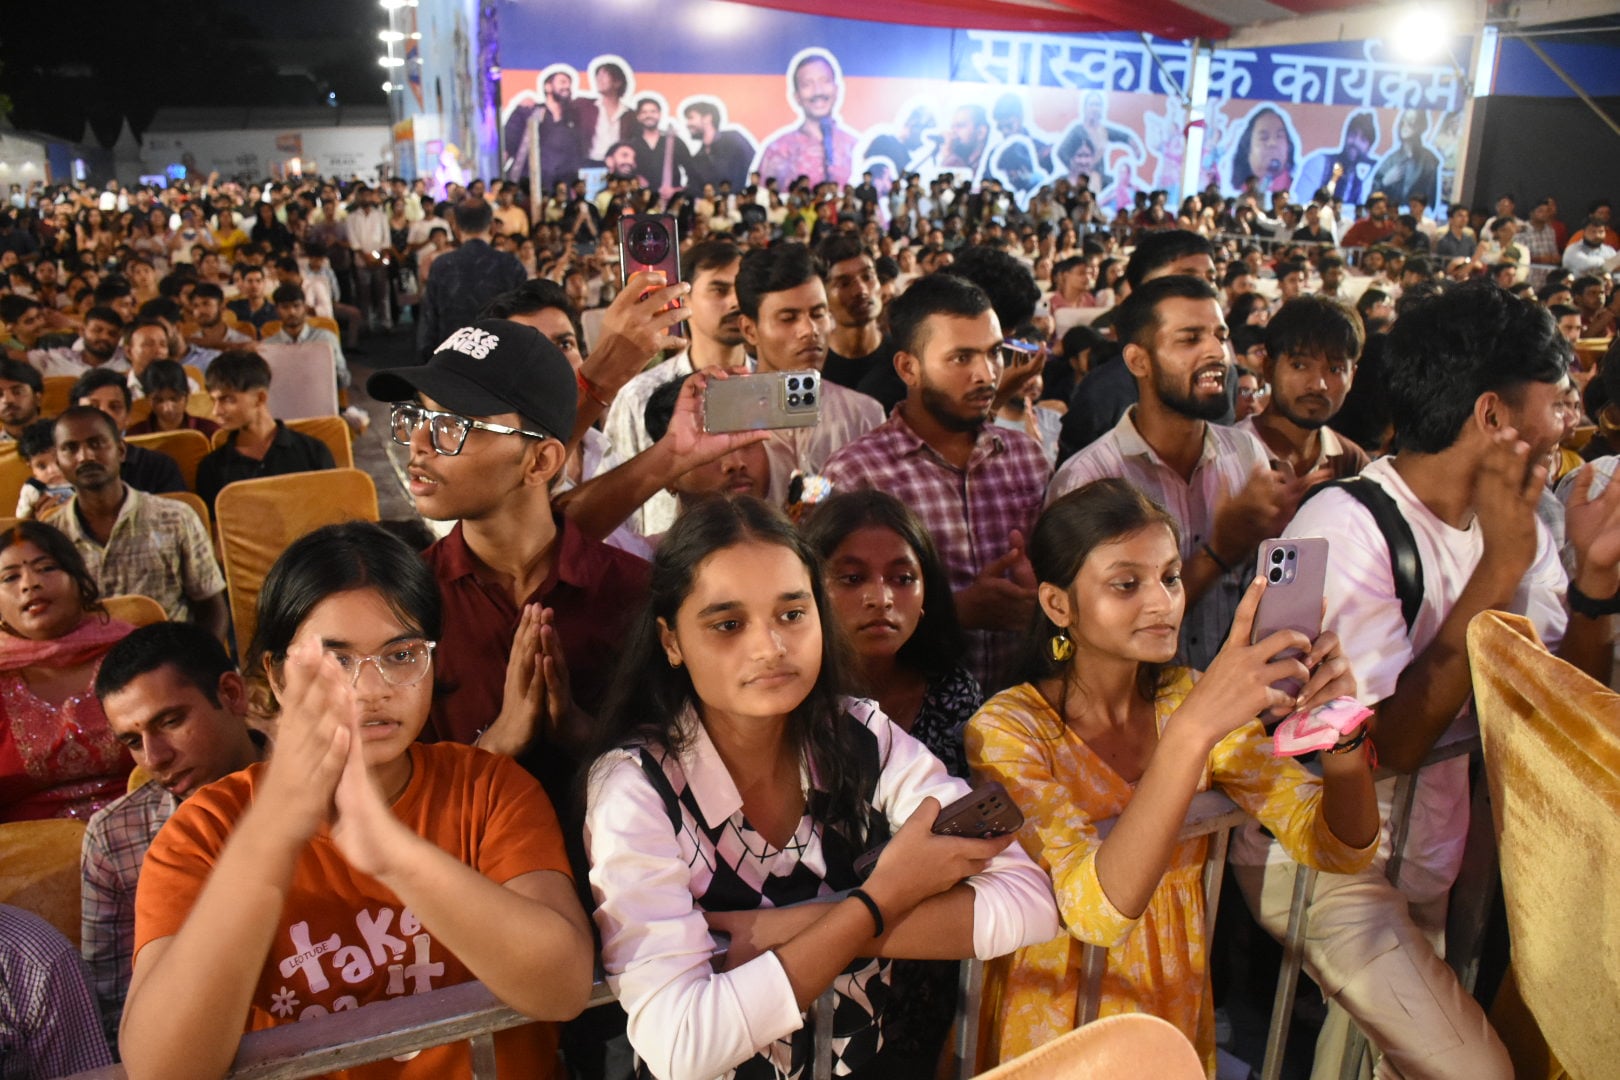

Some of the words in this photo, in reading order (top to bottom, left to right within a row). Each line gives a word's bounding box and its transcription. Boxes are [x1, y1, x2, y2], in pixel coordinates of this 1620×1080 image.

[1270, 39, 1463, 111] कार्यक्रम
[289, 943, 329, 968] LEOTUDE
[386, 934, 445, 995] it
